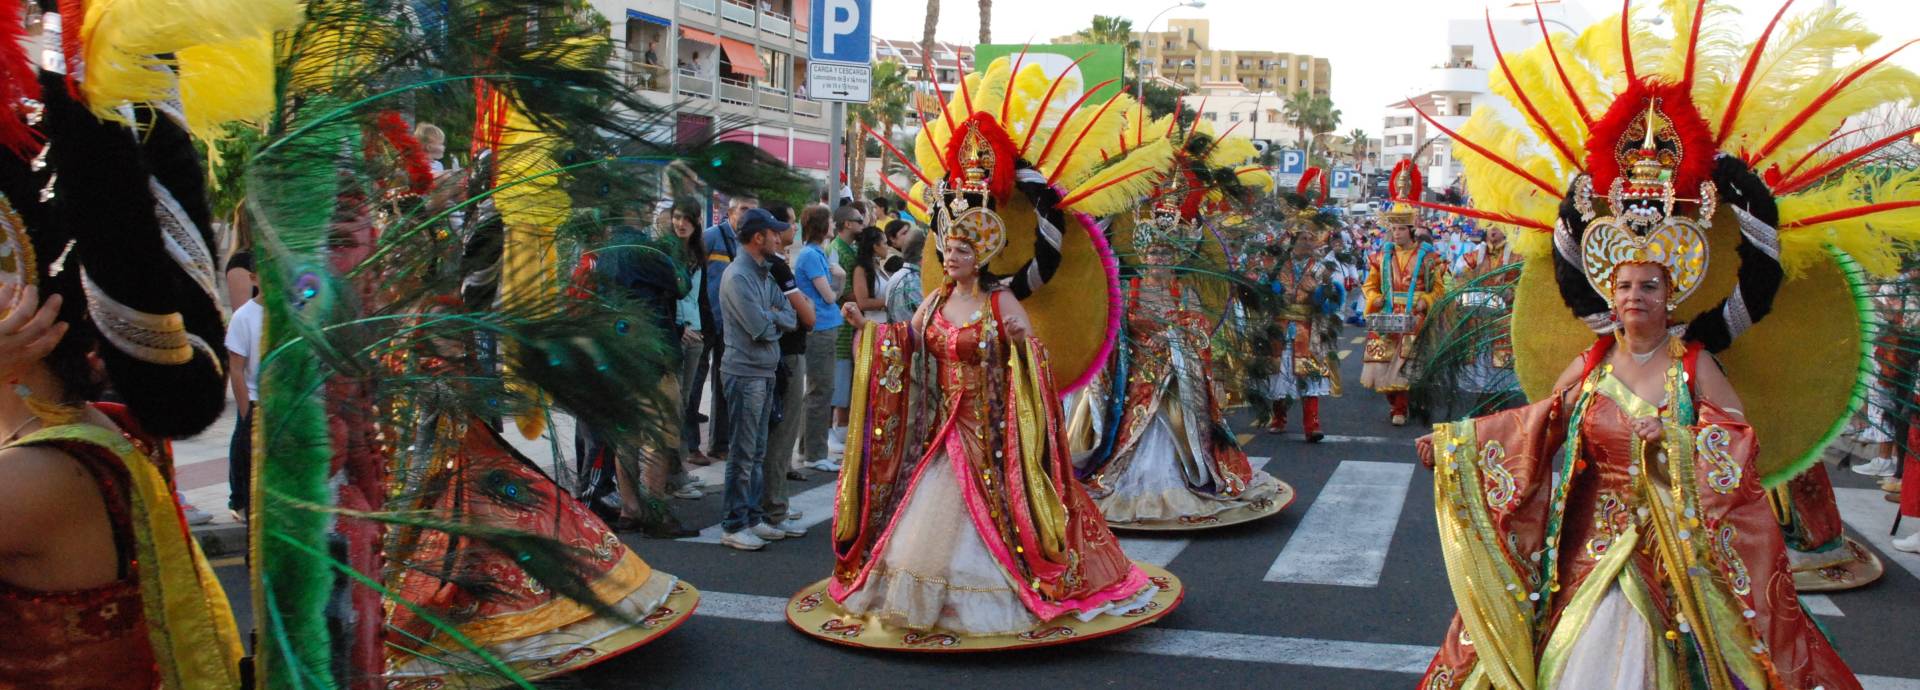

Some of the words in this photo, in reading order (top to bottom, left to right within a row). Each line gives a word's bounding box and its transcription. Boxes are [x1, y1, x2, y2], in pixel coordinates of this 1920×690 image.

[823, 0, 860, 54] P
[1284, 152, 1299, 172] P
[1334, 171, 1346, 187] P
